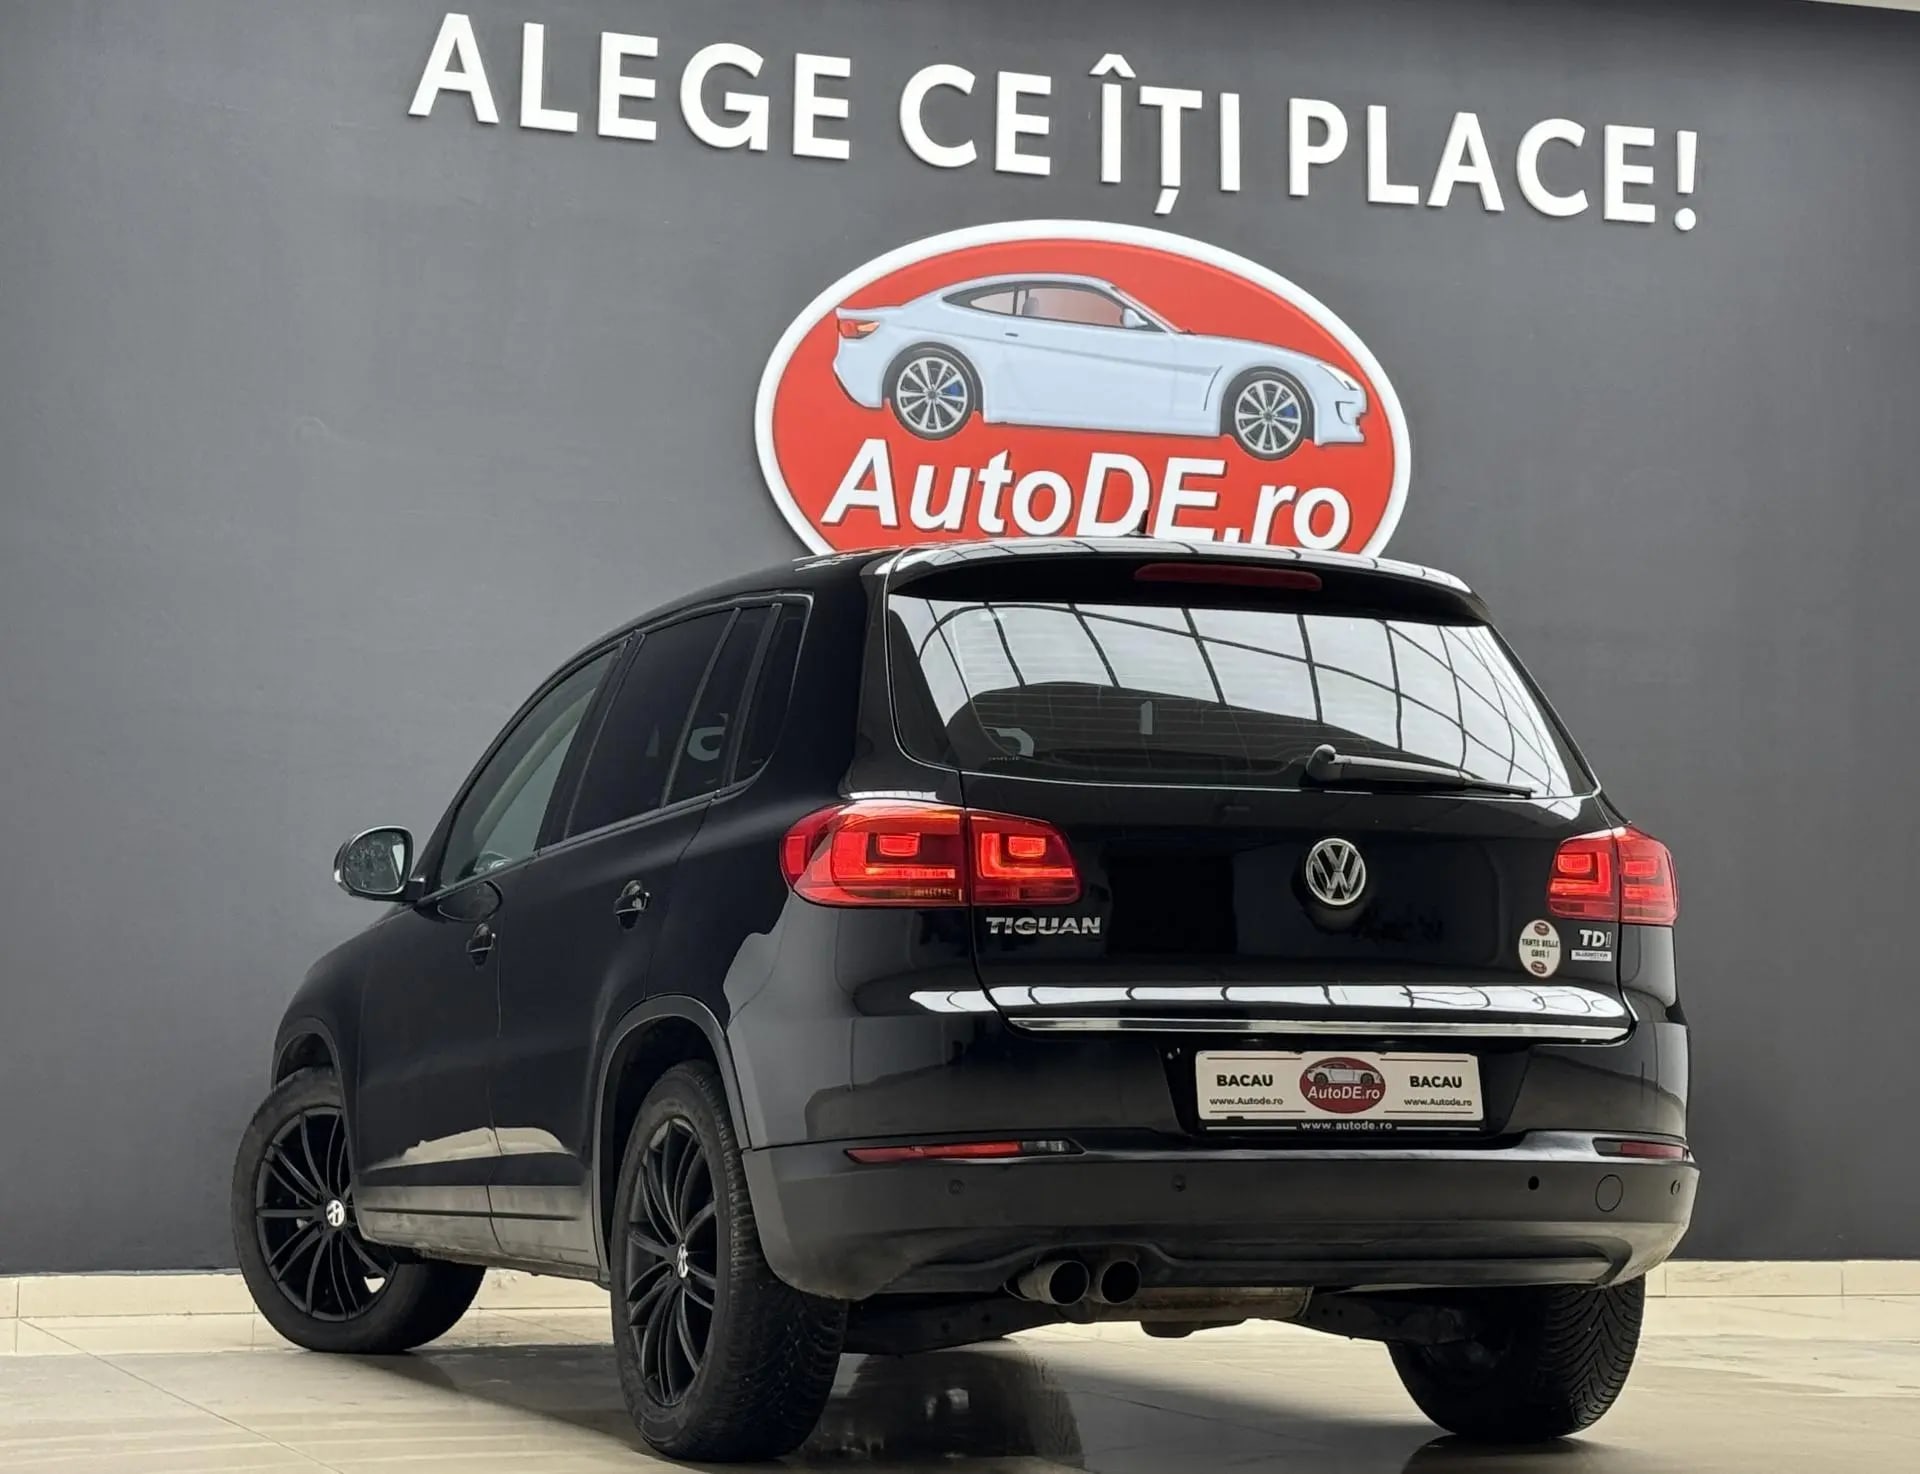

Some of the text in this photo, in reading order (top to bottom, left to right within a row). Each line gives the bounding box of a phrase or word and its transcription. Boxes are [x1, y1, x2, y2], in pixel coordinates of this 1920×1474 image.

[408, 12, 1698, 232] ALEGE CE ÎȚI PLACE!
[821, 438, 1351, 551] AutoDE.ro
[986, 916, 1101, 935] TIGUAN
[1216, 1074, 1274, 1087] BACAU
[1409, 1075, 1462, 1088] BACAU
[1307, 1086, 1380, 1099] AutoDE.ro
[1209, 1096, 1284, 1105] www.Autode.ro
[1301, 1121, 1393, 1130] www.autode.ro
